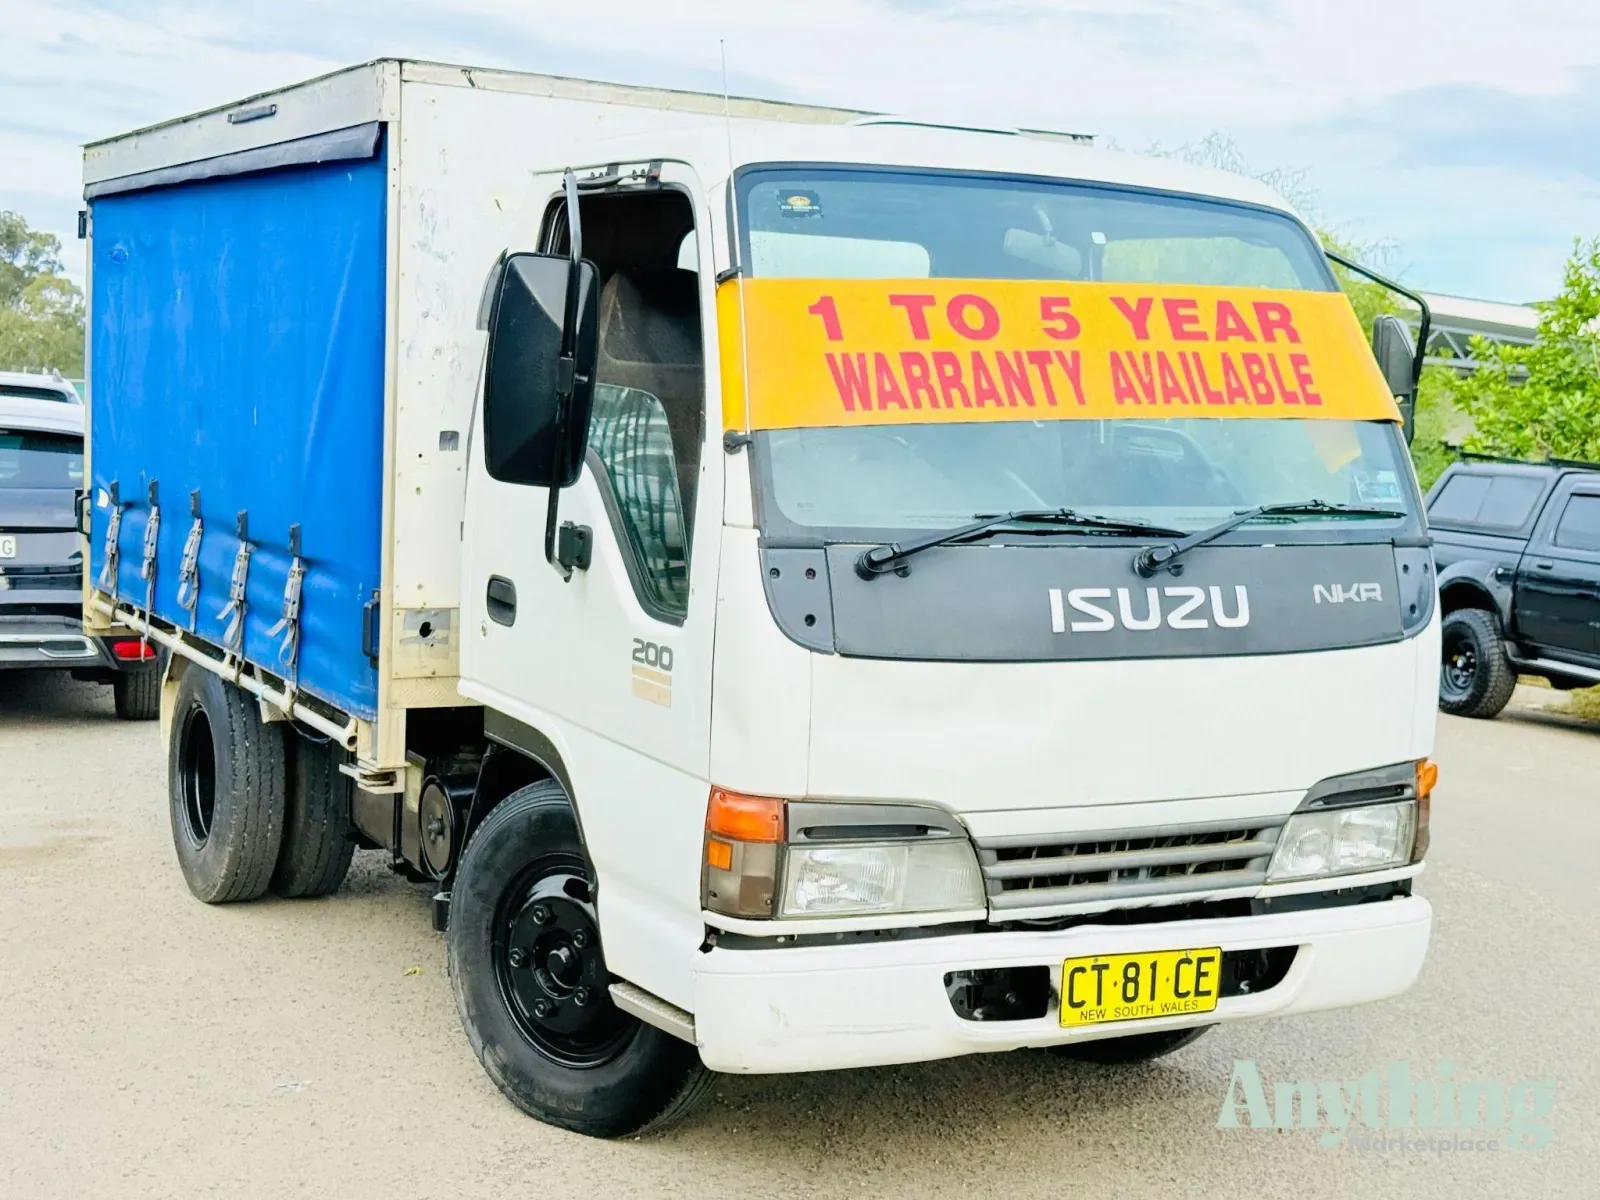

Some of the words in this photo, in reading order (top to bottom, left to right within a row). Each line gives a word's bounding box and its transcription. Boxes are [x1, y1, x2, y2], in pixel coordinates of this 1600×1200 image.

[808, 295, 844, 341] 1
[889, 294, 1000, 341] TO
[1040, 296, 1081, 340] 5
[1108, 296, 1301, 343] YEAR
[824, 350, 1087, 411] WARRANTY
[1109, 350, 1324, 405] AVAILABLE
[1048, 585, 1250, 633] ISUZU
[1313, 582, 1383, 603] NKR
[632, 637, 674, 672] 200
[1080, 1008, 1107, 1021] NEW
[1114, 1004, 1154, 1018] SOUTH
[1160, 999, 1198, 1013] WALES
